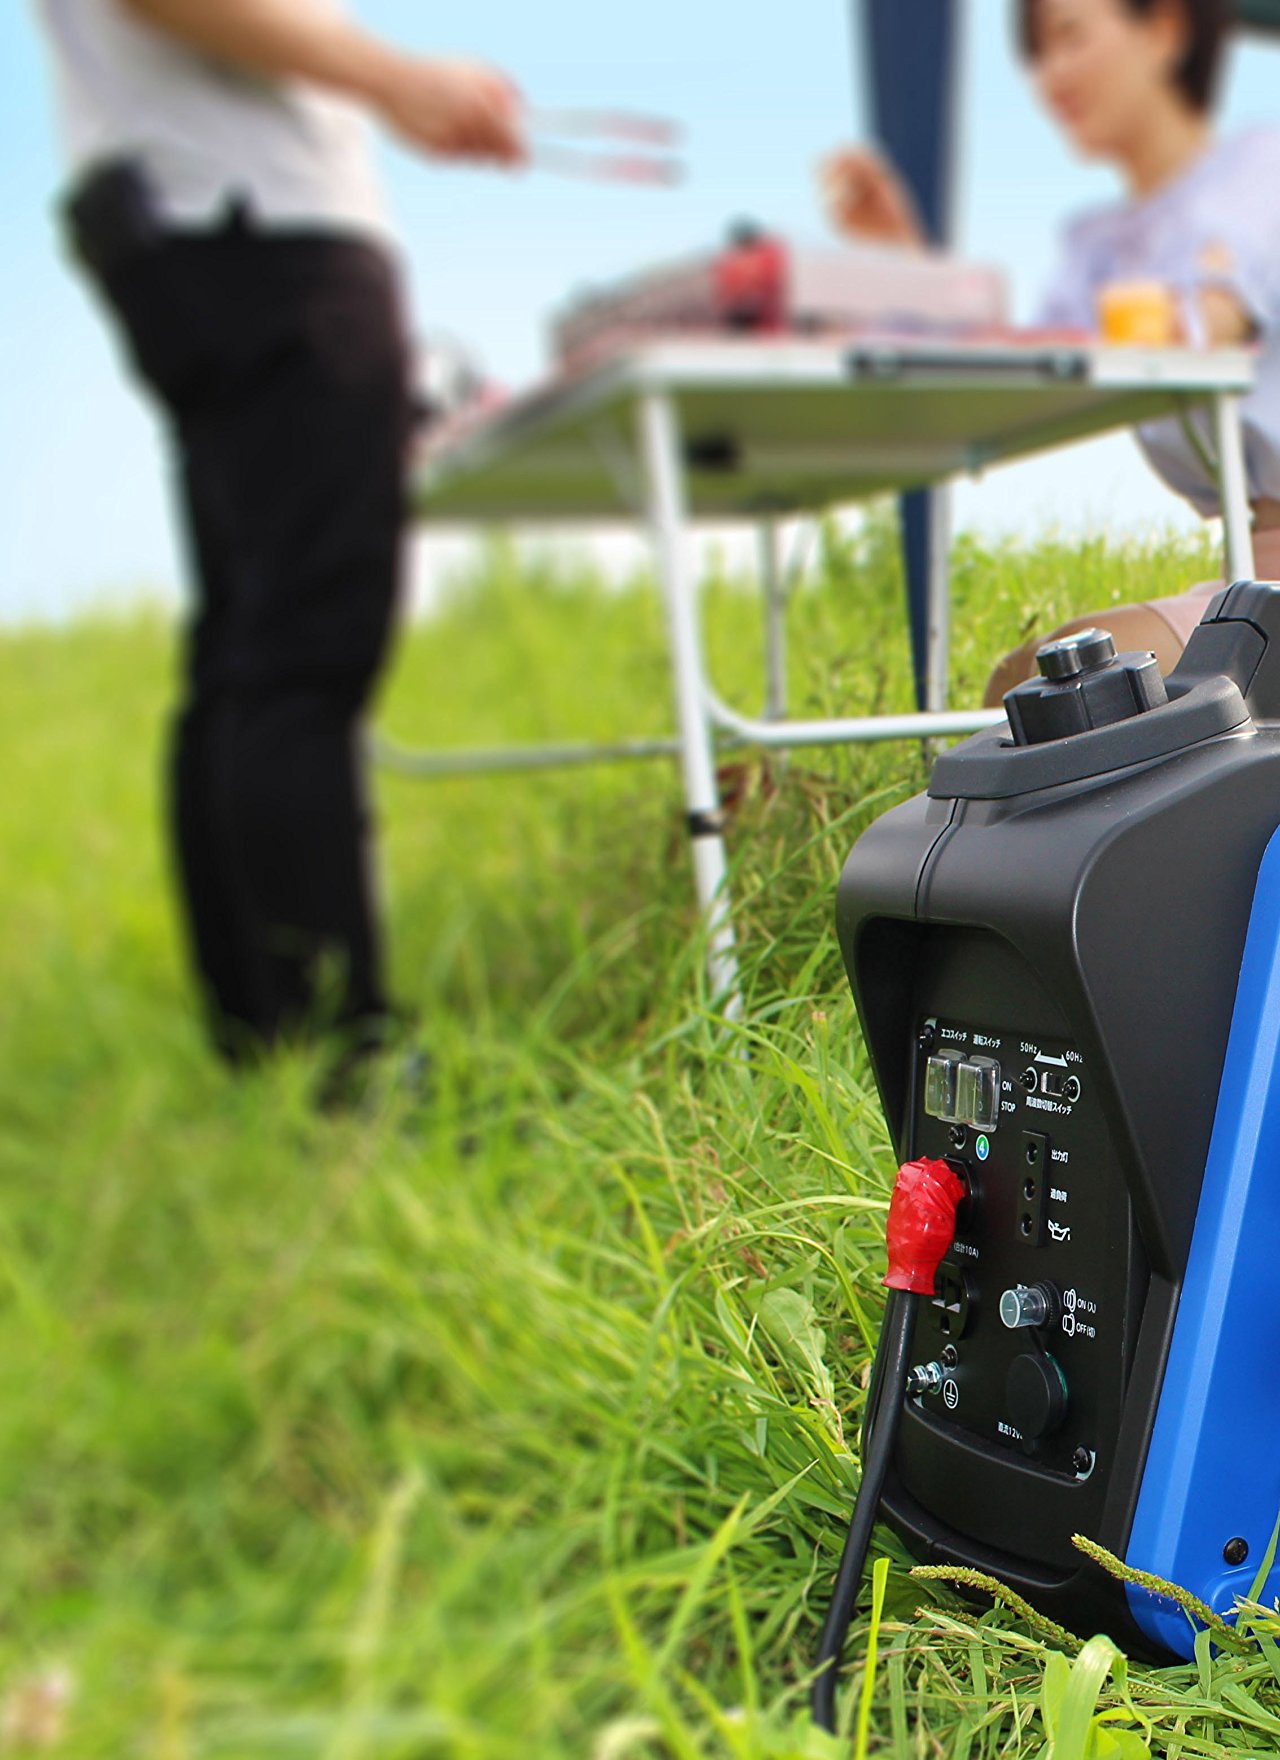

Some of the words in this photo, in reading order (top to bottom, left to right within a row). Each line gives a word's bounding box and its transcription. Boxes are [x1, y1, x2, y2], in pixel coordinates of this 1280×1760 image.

[1020, 1042, 1037, 1054] 50Hz
[1065, 1050, 1083, 1063] 60Hz
[1002, 1081, 1012, 1091] ON
[1001, 1101, 1015, 1112] STOP
